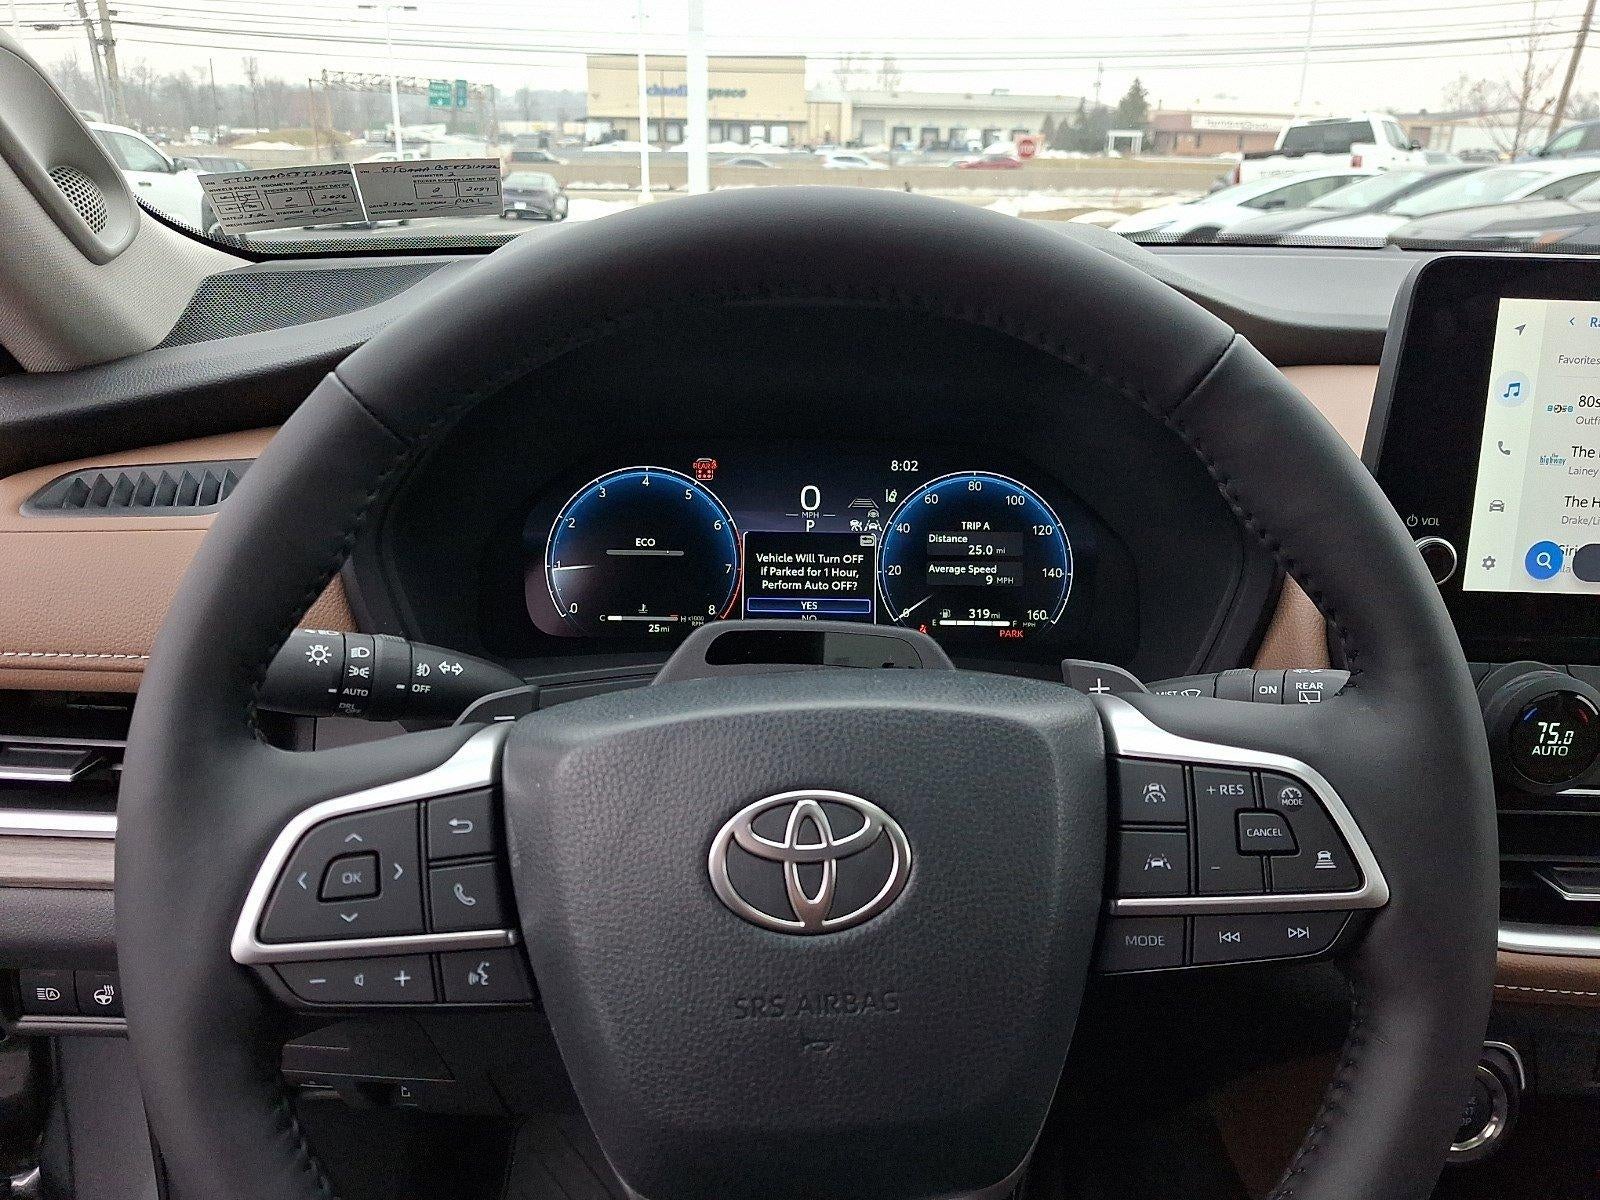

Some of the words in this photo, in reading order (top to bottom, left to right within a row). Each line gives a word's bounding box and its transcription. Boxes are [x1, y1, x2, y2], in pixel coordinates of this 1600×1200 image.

[1558, 355, 1600, 365] Favorites
[1578, 396, 1600, 408] 80s
[1572, 446, 1596, 458] The
[891, 460, 918, 472] 8:02
[1568, 467, 1599, 478] Lainey
[642, 478, 650, 486] 4
[968, 482, 982, 492] 80
[599, 488, 606, 498] 3
[686, 490, 692, 500] 5
[800, 485, 820, 510] 0
[924, 494, 938, 504] 60
[1006, 496, 1025, 506] 100
[1564, 496, 1588, 508] The
[568, 518, 576, 528] 2
[714, 520, 722, 530] 6
[806, 520, 816, 532] P
[962, 522, 981, 530] TRIP
[983, 522, 990, 530] A
[1421, 517, 1440, 526] VOL
[896, 523, 910, 532] 40
[1032, 526, 1052, 536] 120
[636, 538, 656, 546] ECO
[928, 534, 968, 543] Distance
[968, 544, 993, 555] 25.0
[756, 553, 794, 562] Vehicle
[795, 554, 816, 563] Will
[818, 554, 840, 564] Turn
[842, 554, 864, 564] OFF
[726, 564, 732, 574] 7
[770, 567, 804, 576] Parked
[807, 567, 821, 576] for
[824, 568, 828, 576] 1
[832, 568, 859, 578] Hour,
[888, 566, 902, 576] 20
[928, 564, 966, 575] Average
[968, 565, 997, 575] Speed
[1042, 568, 1062, 578] 140
[762, 580, 802, 590] Perform
[804, 580, 829, 590] Auto
[832, 582, 858, 590] OFF?
[986, 575, 994, 585] 9
[570, 604, 578, 614] 0
[708, 604, 716, 615] 8
[801, 602, 818, 610] YES
[1027, 610, 1047, 620] 160
[1000, 629, 1024, 638] PARK
[412, 684, 431, 694] OFF
[1259, 686, 1277, 694] ON
[1296, 682, 1323, 690] REAR
[342, 688, 368, 696] AUTO
[1538, 722, 1574, 744] 75.0
[1532, 746, 1568, 756] AUTO
[1281, 798, 1304, 806] MODE
[1246, 828, 1282, 837] CANCEL
[342, 872, 362, 884] OK
[1126, 936, 1165, 946] MODE
[735, 997, 784, 1019] SRS
[794, 992, 900, 1016] AIRBAG
